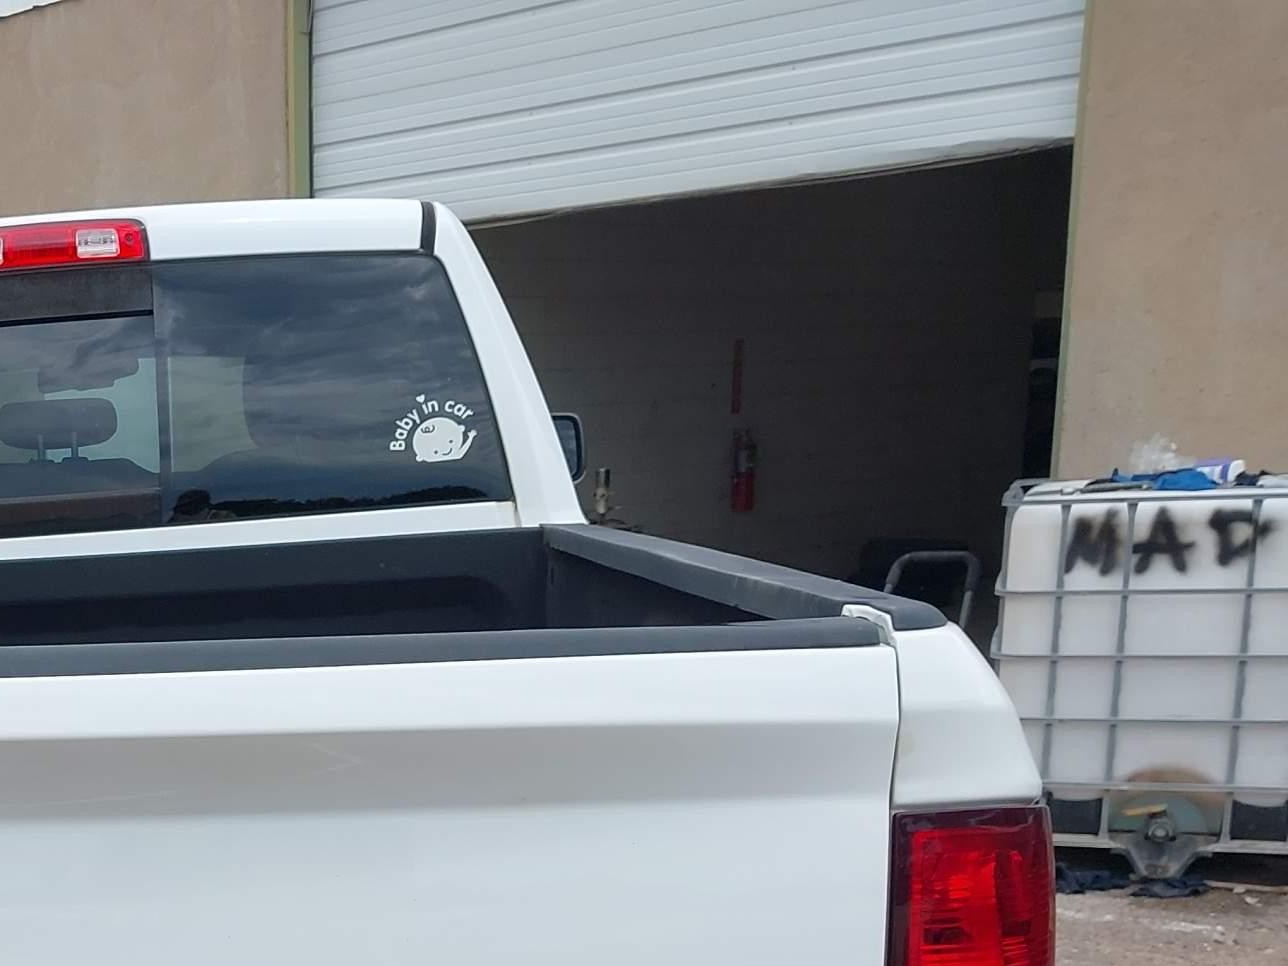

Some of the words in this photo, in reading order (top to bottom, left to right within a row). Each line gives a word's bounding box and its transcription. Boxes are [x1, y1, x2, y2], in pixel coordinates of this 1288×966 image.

[389, 408, 421, 451] Baby
[415, 394, 439, 415] in
[444, 400, 474, 419] car
